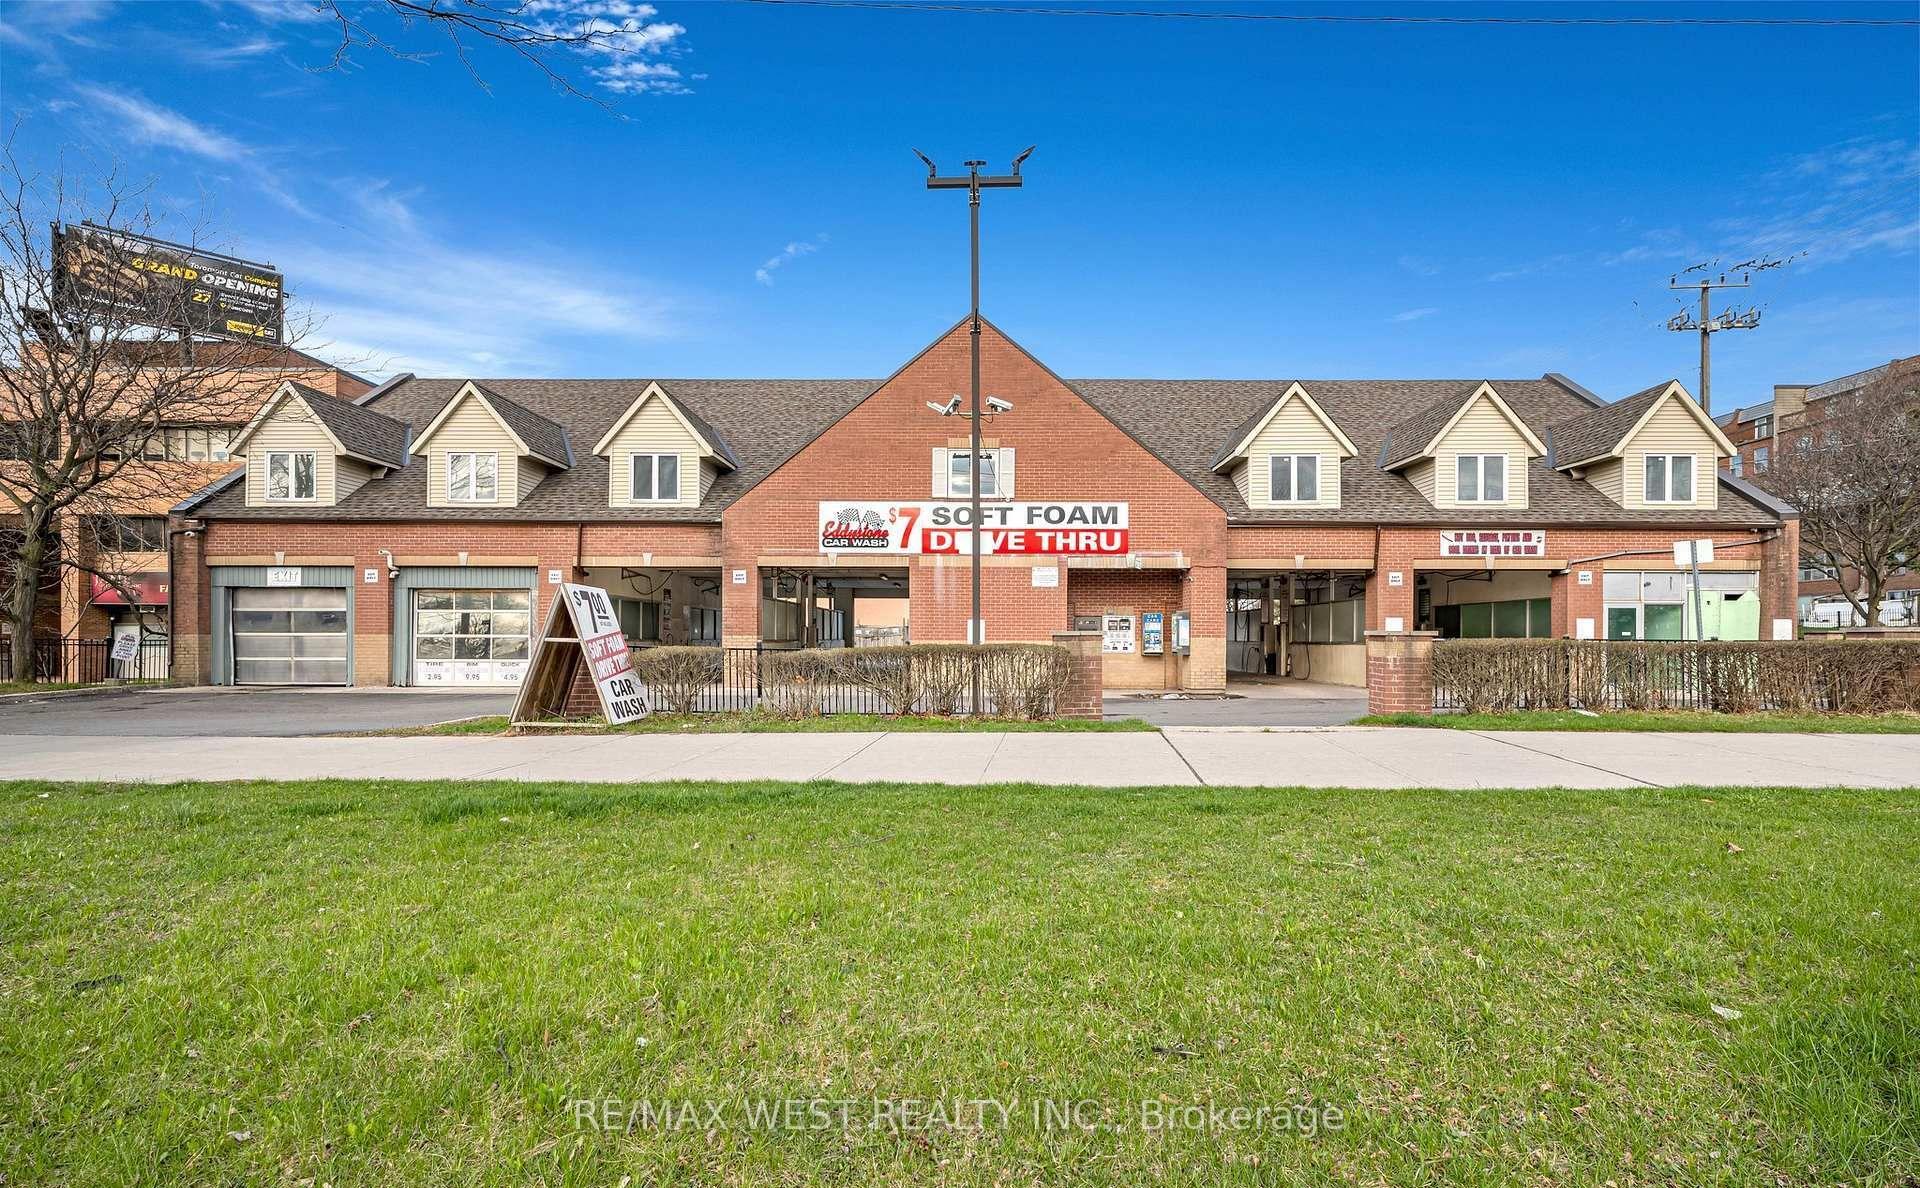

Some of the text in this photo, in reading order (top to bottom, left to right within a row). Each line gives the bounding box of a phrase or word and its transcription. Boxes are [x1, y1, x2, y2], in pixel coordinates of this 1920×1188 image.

[131, 256, 199, 281] GRAND
[201, 273, 279, 299] OPENING
[244, 275, 279, 288] Compact
[888, 505, 1119, 548] $7 SOFT FOAM
[823, 538, 888, 548] CAR WASH
[1036, 530, 1121, 551] THRU
[272, 568, 299, 582] EXIT
[587, 632, 626, 660] SOFT FOAM
[594, 656, 617, 679] DRIVE
[610, 678, 636, 698] CAR
[611, 696, 648, 720] WASH
